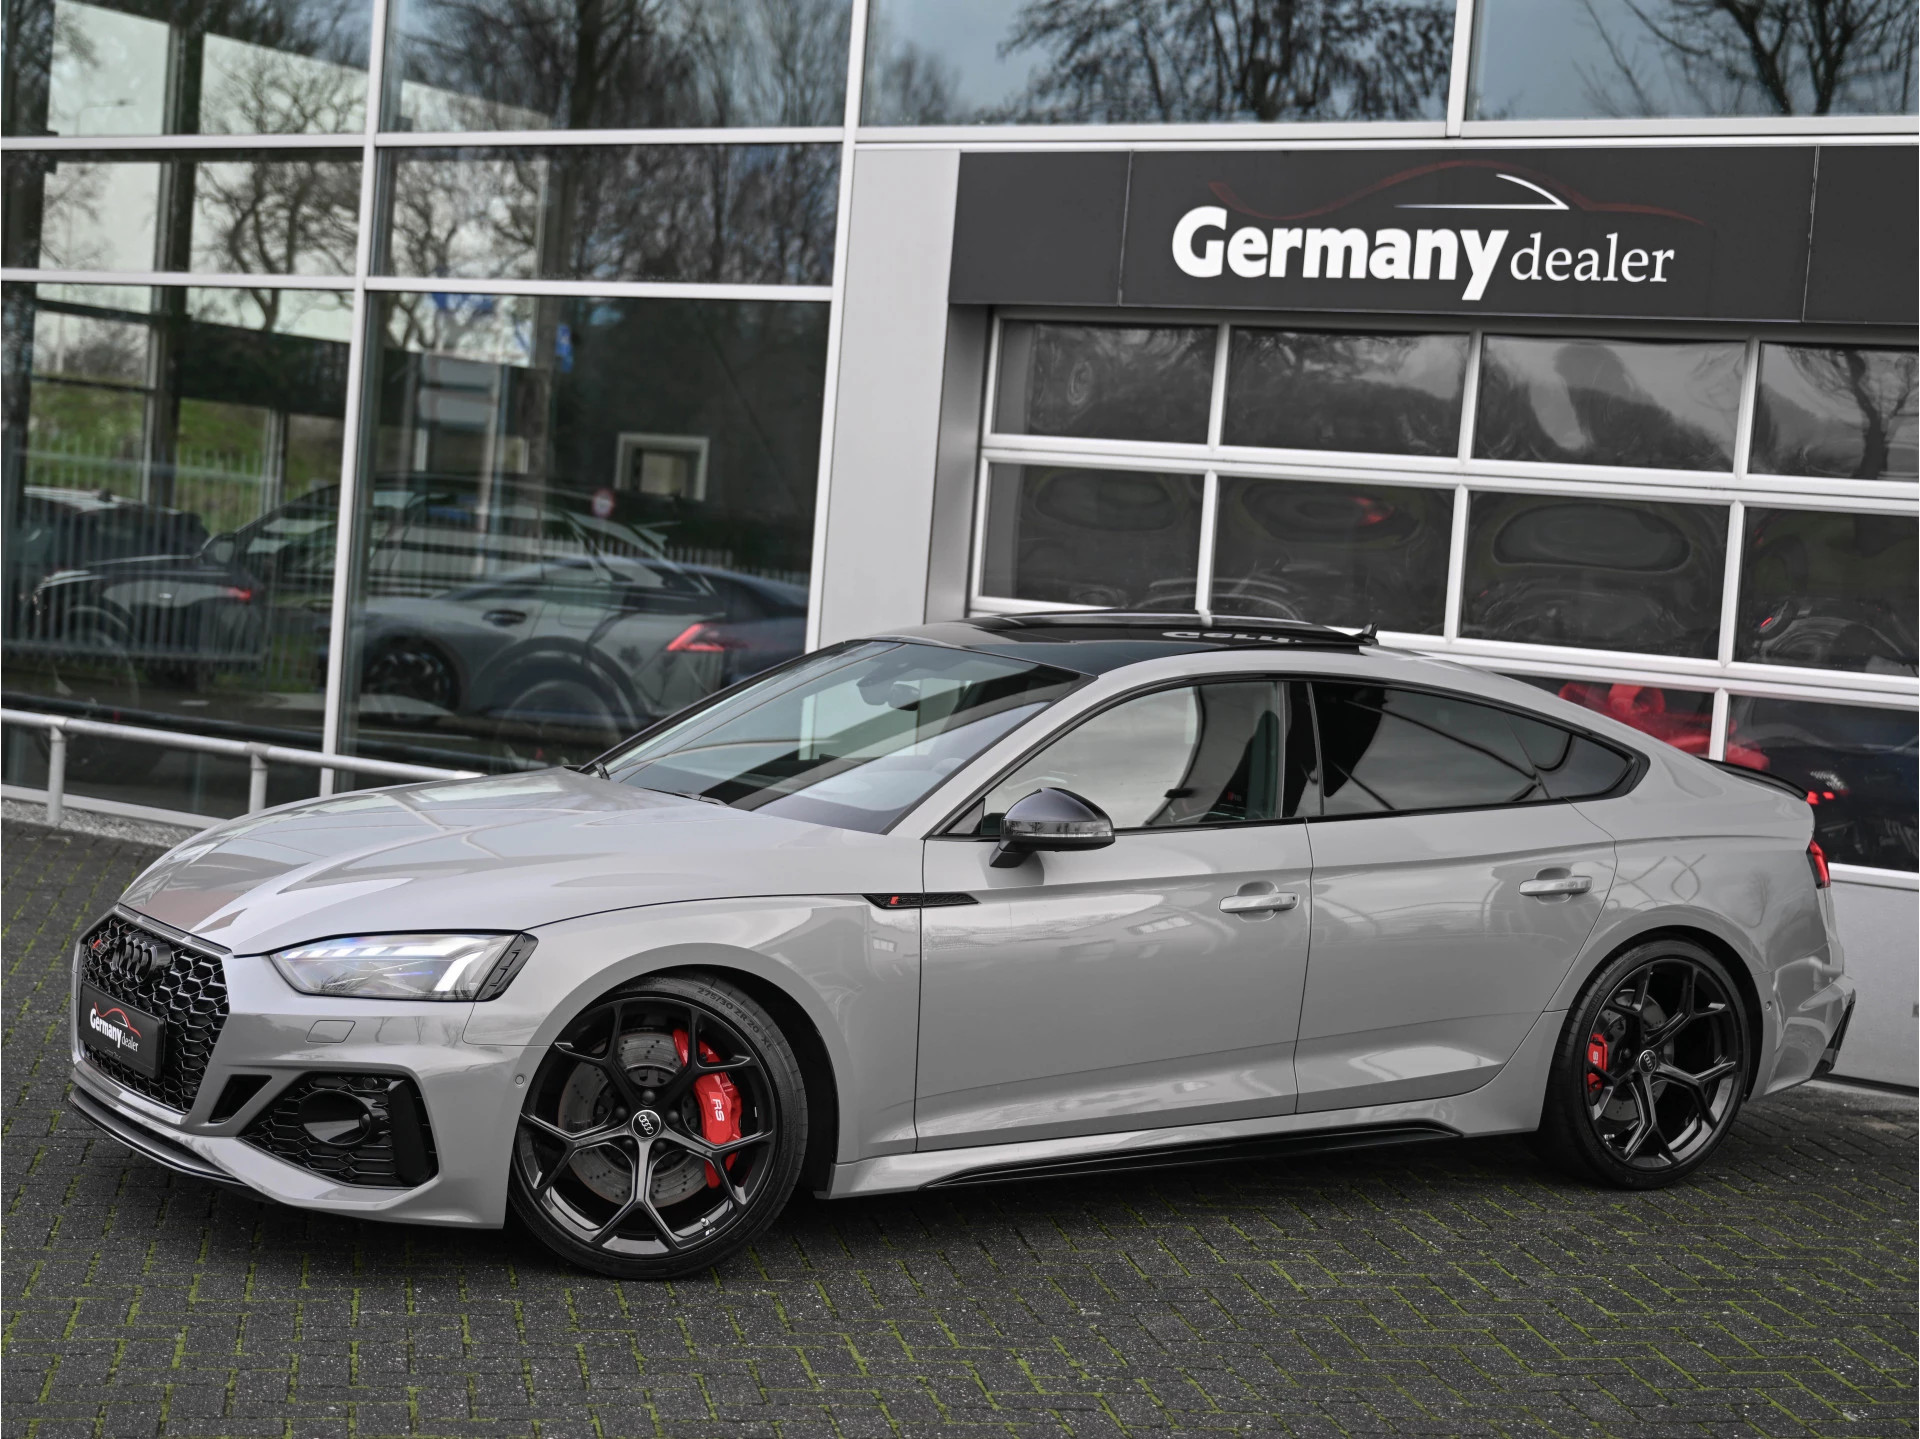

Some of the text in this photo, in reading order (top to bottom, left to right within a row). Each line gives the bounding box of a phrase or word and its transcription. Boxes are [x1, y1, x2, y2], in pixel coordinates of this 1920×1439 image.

[1172, 206, 1675, 300] Germany dealer
[90, 1008, 122, 1049] Germany
[121, 1032, 139, 1053] dealer
[697, 987, 773, 1050] 275/30 ZR 20 XL
[712, 1098, 725, 1122] RS
